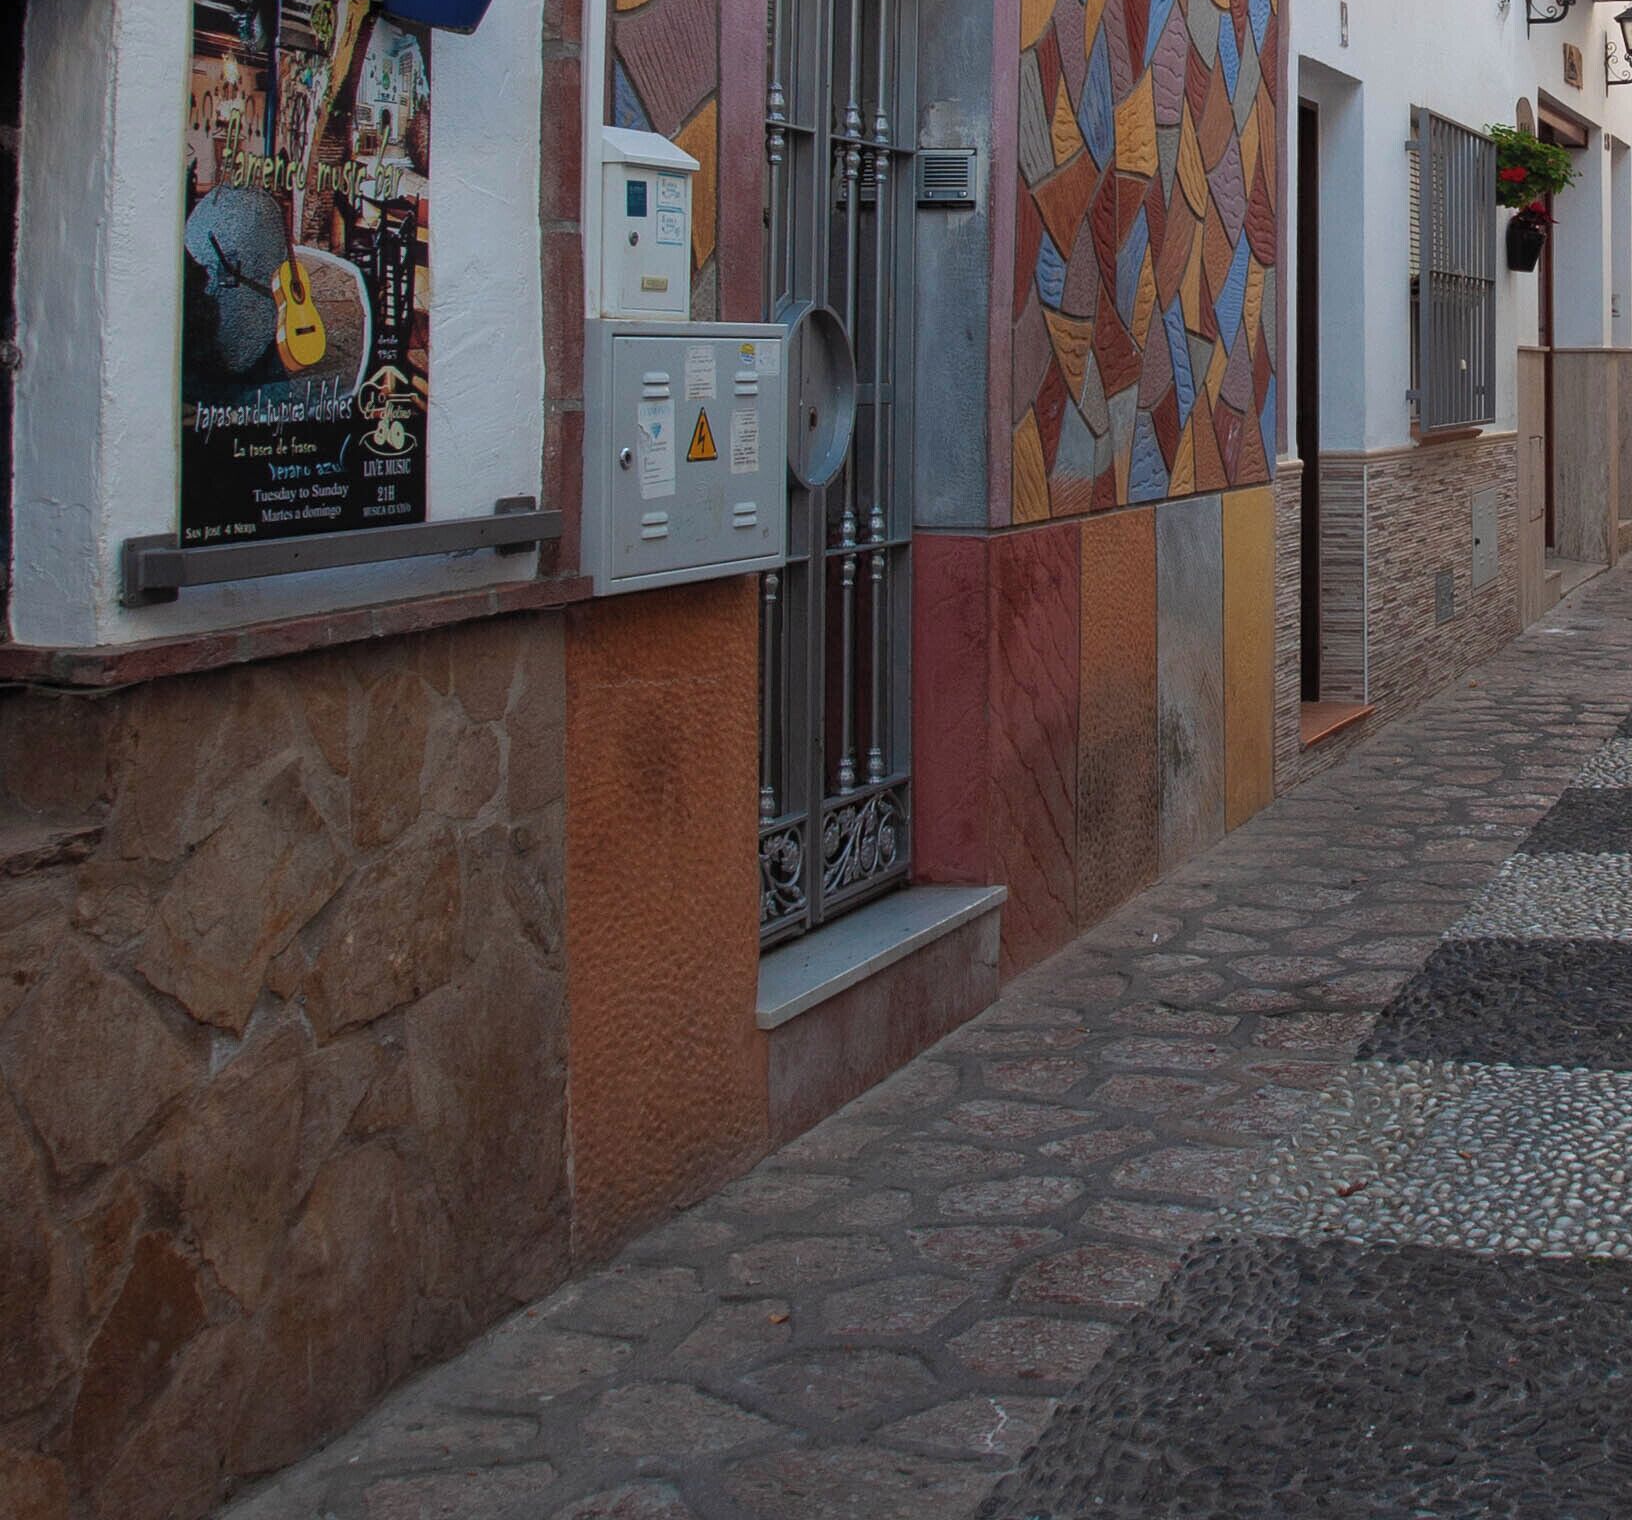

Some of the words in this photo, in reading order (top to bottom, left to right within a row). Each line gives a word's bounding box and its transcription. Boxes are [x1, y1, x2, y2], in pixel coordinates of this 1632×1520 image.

[317, 138, 366, 205] music
[375, 124, 403, 199] bar
[237, 388, 262, 425] and
[266, 380, 311, 437] typical
[315, 375, 353, 424] dishes
[233, 438, 246, 458] La
[275, 438, 288, 455] de
[363, 458, 384, 477] LIVE
[385, 458, 411, 475] MUSIC
[252, 488, 296, 503] Tuesday
[298, 487, 310, 499] to
[311, 483, 350, 499] Sunday
[377, 484, 396, 502] 21H
[261, 508, 293, 523] Martes
[302, 504, 342, 521] domingo
